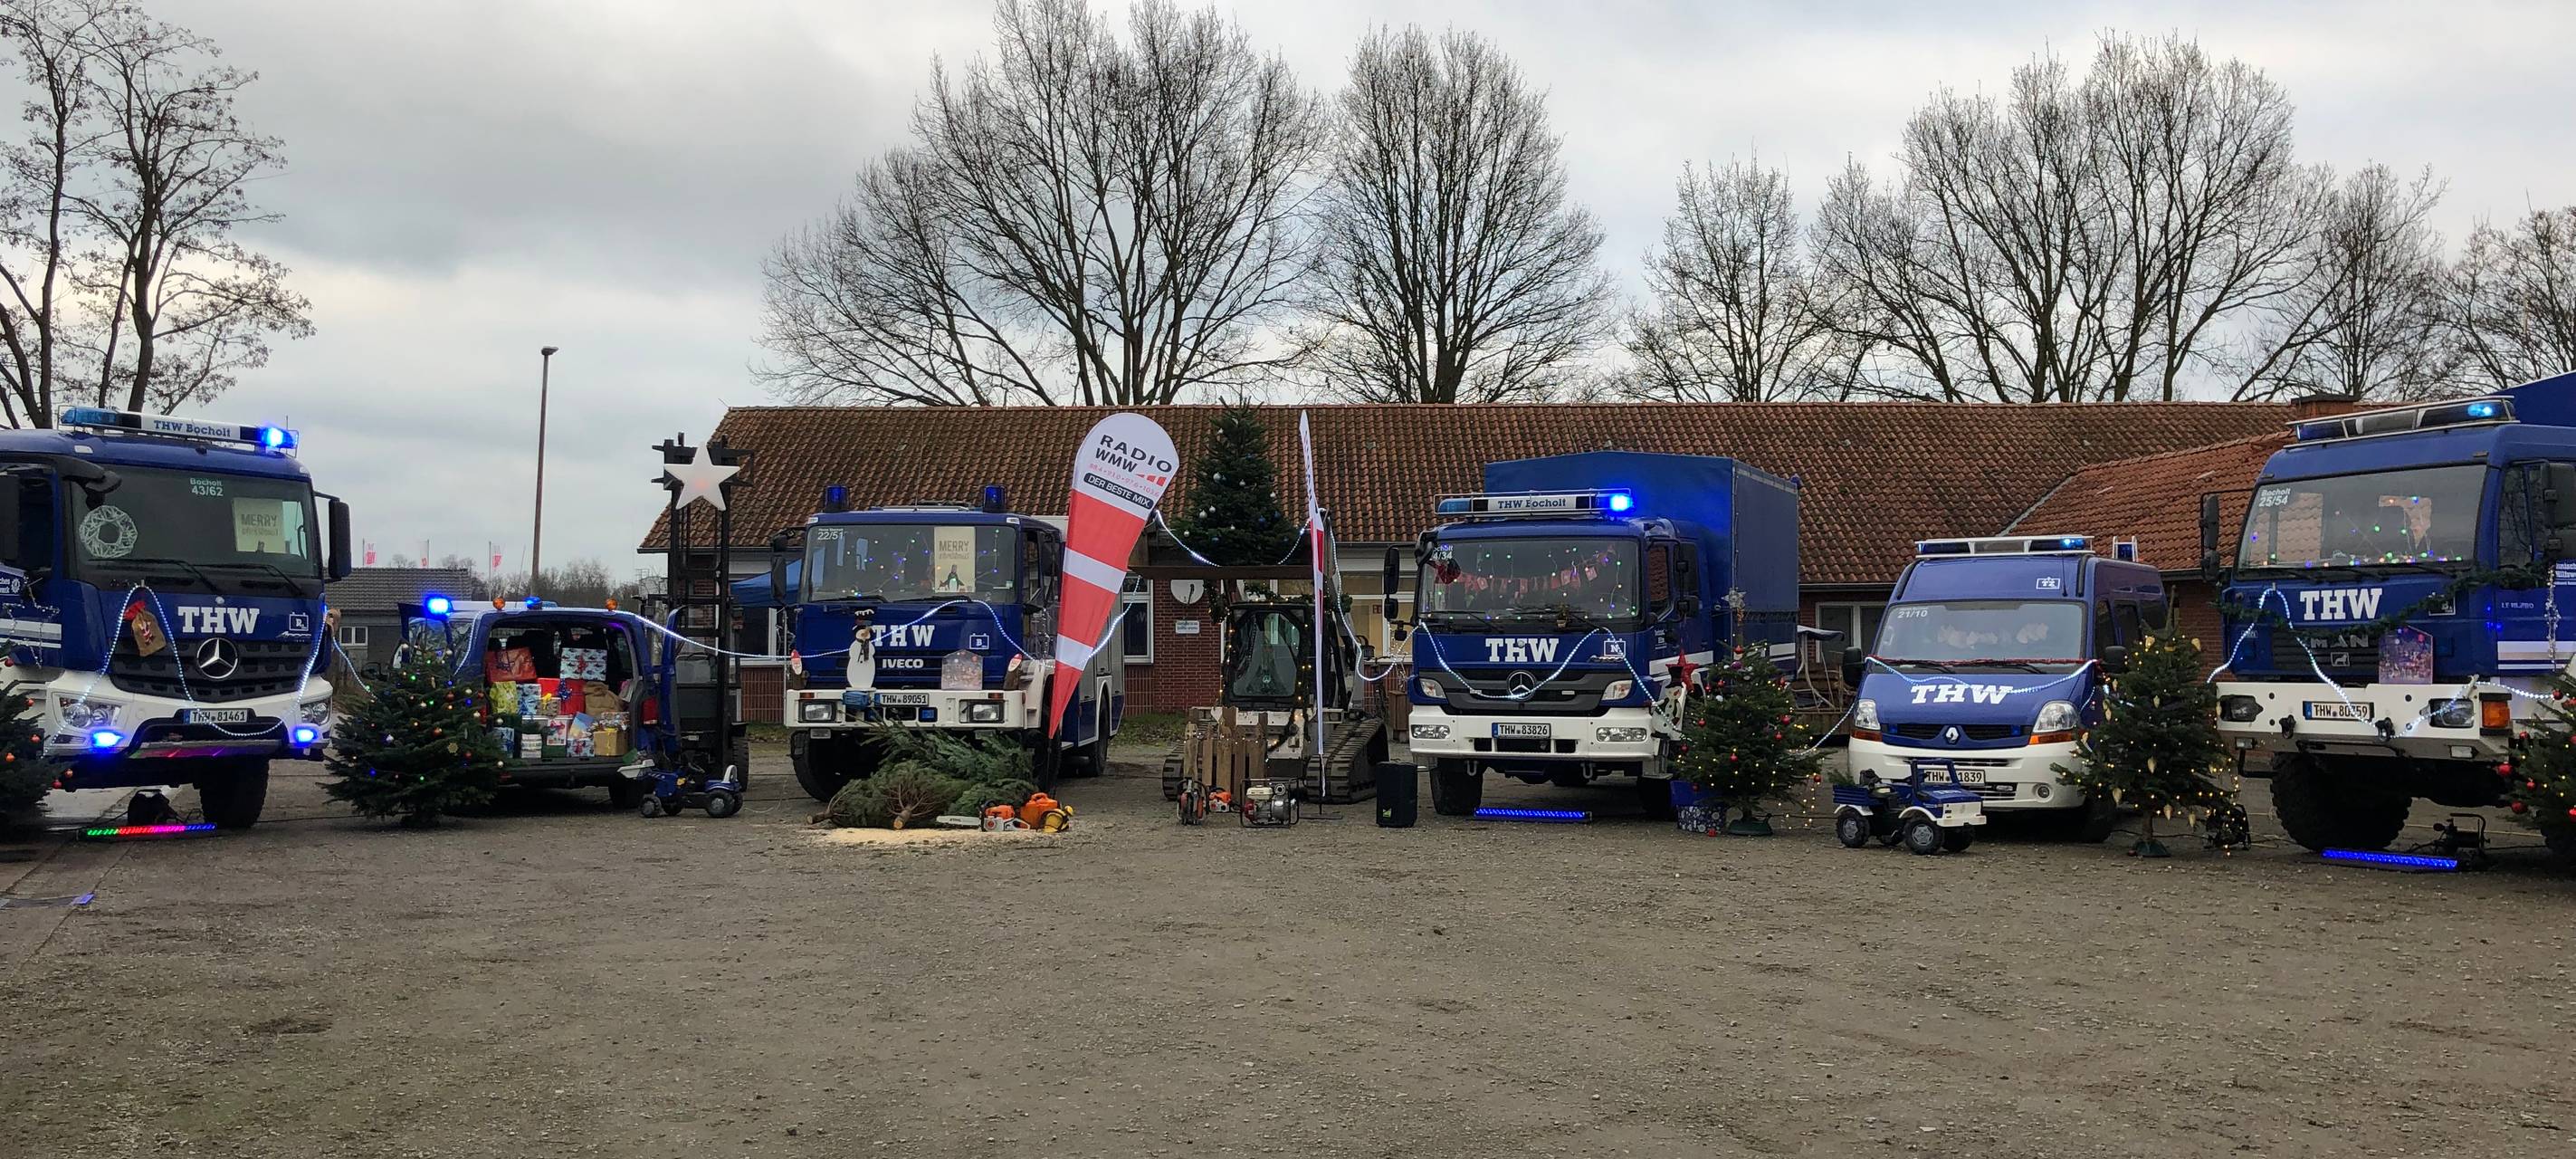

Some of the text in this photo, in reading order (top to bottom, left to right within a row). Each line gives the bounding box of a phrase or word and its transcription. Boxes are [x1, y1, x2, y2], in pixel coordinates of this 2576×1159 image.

[154, 420, 231, 436] THW Bocholt
[1095, 447, 1138, 473] WMW
[1100, 435, 1172, 473] RADIO
[190, 478, 224, 486] Bocholt
[191, 485, 224, 496] 43/62
[1088, 475, 1150, 508] DER BESTE MIX
[2261, 488, 2291, 496] Bocholt
[1498, 498, 1566, 509] THW Bocholt
[2258, 495, 2288, 507] 25/54
[241, 514, 278, 527] MERRY
[817, 532, 844, 541] 22/51
[939, 541, 970, 551] MERRY
[2300, 589, 2382, 620] THW
[178, 607, 260, 634] THW
[872, 625, 936, 647] THW
[2310, 635, 2369, 648] MAN
[1485, 638, 1559, 662] THW
[883, 658, 923, 668] IVECO
[883, 695, 927, 704] THW 89051
[1911, 684, 2013, 704] THW
[2314, 704, 2332, 716] THW
[217, 712, 245, 722] 81461
[1499, 724, 1548, 735] THW 83826
[1926, 771, 1982, 783] THW 1839
